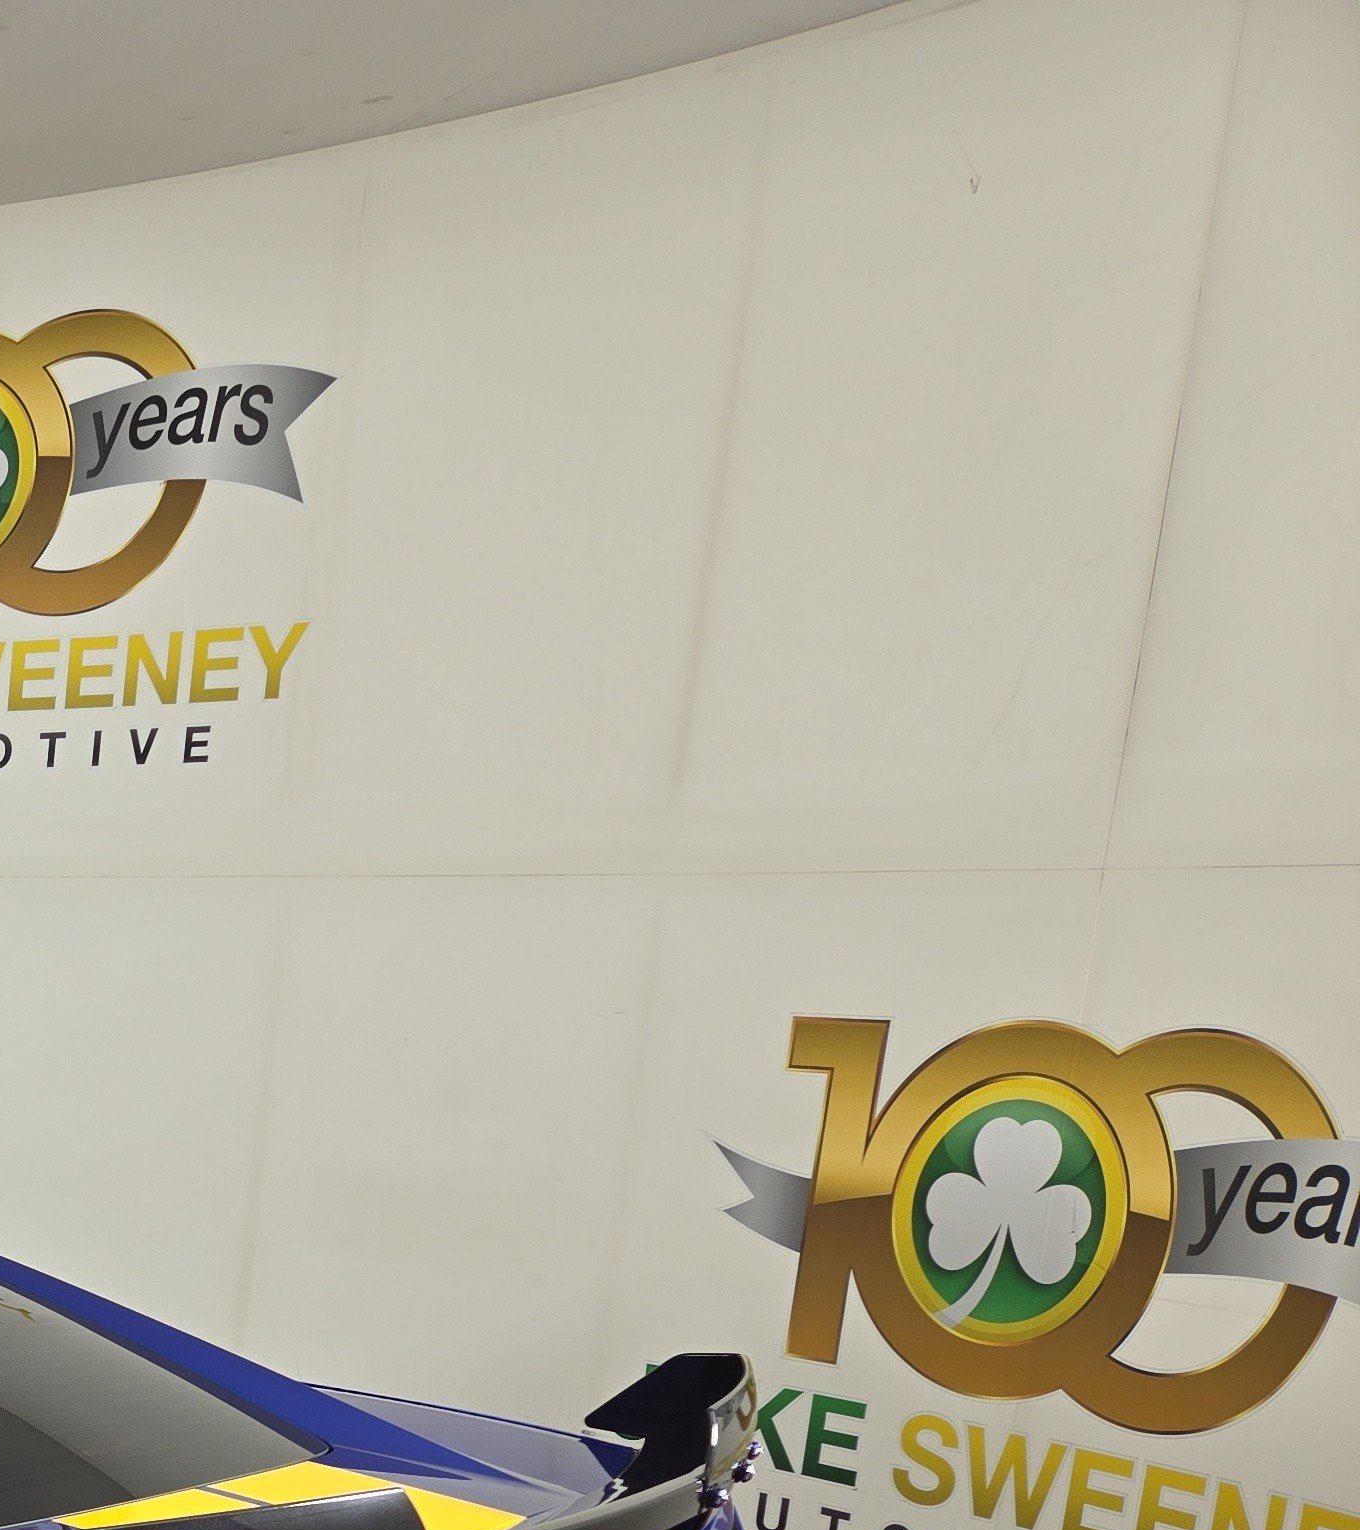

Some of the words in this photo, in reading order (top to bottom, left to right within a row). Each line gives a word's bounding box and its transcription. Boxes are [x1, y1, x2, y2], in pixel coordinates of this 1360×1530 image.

[85, 383, 274, 480] years
[786, 1016, 1338, 1436] 100
[1186, 1162, 1360, 1257] yea
